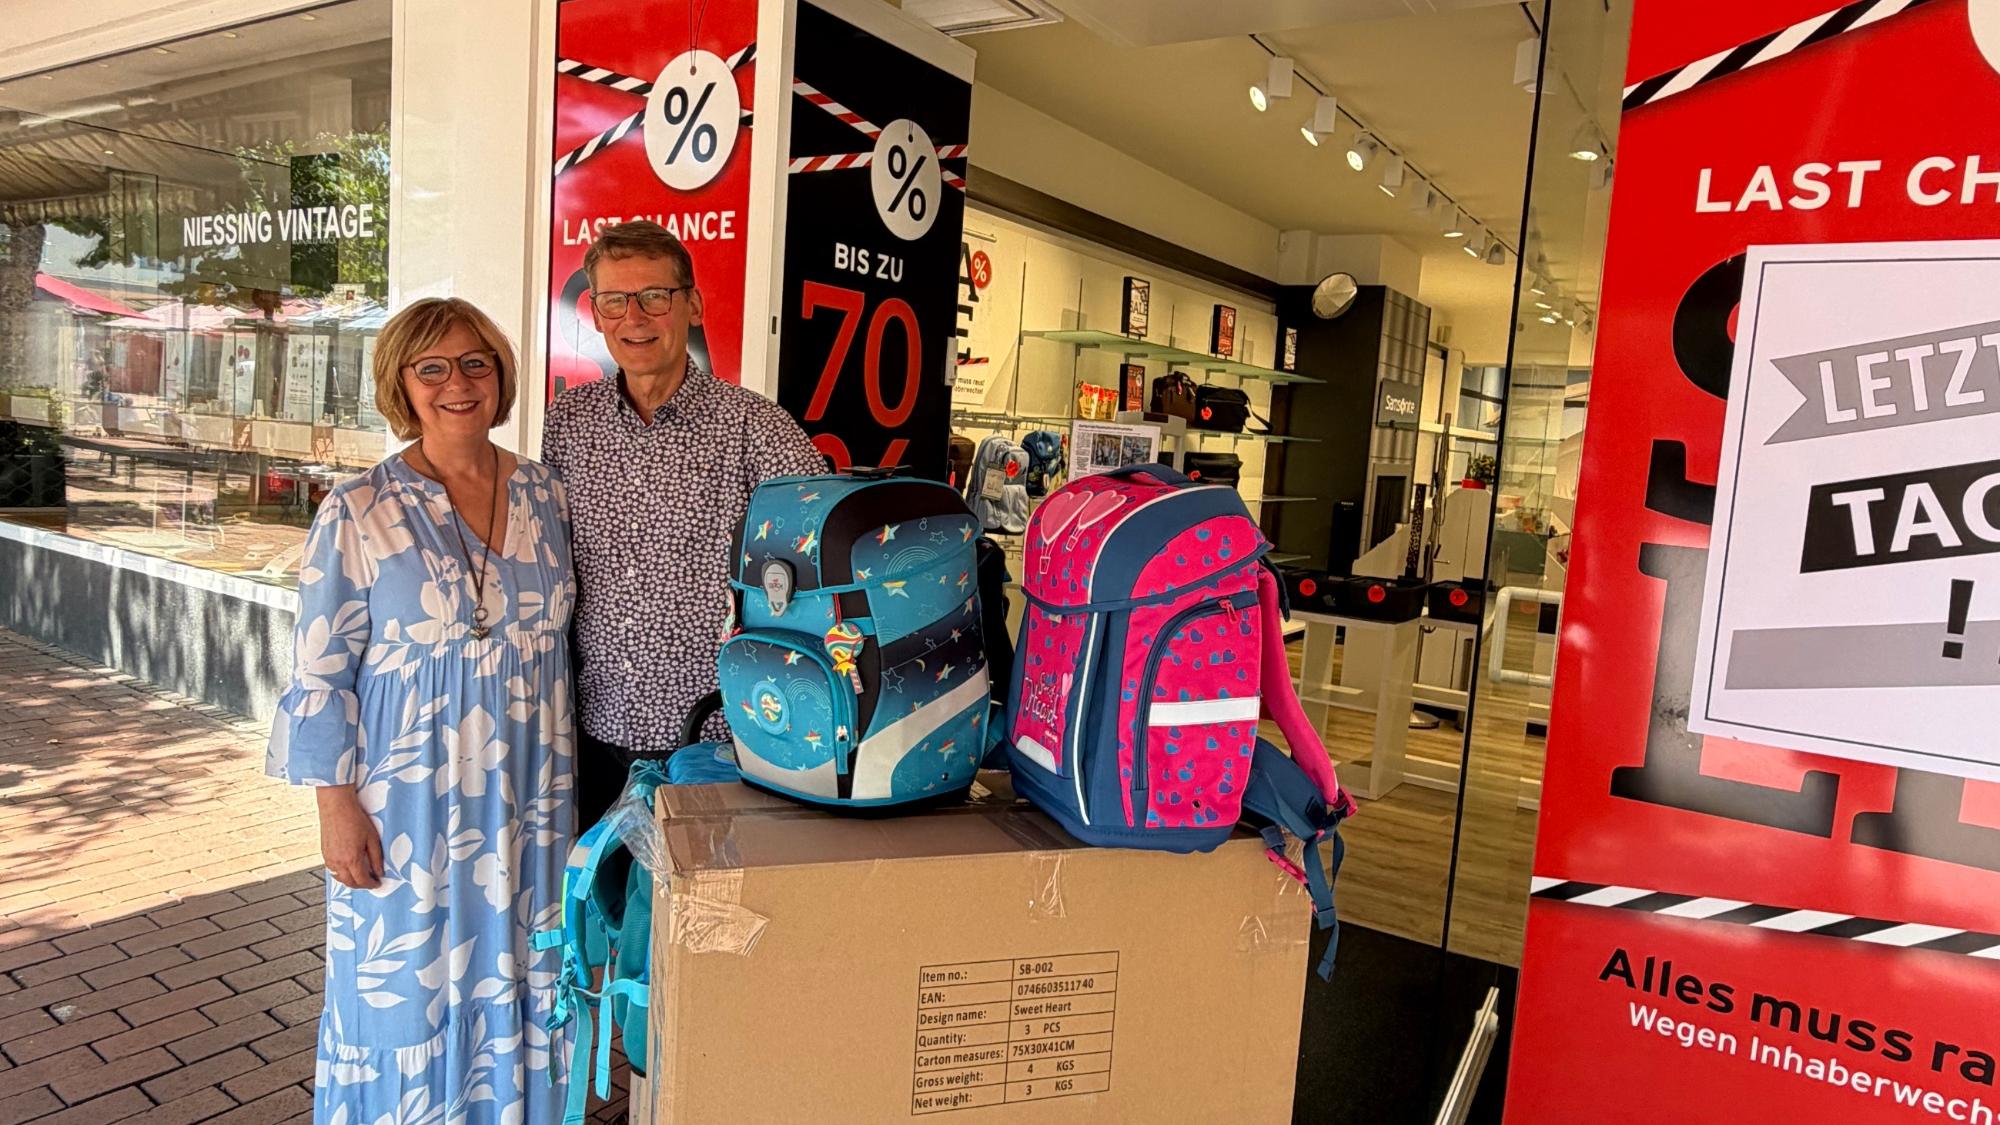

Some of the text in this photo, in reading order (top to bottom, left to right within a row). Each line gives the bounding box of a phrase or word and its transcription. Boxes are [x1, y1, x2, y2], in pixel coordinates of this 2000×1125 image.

[663, 82, 718, 165] %
[887, 144, 927, 222] %
[1695, 160, 1882, 213] LAST
[183, 203, 374, 247] NIESSING VINTAGE
[563, 210, 736, 246] LAS ANCE
[834, 242, 903, 283] BIS ZU
[802, 280, 922, 428] 70
[1942, 578, 1975, 660] !
[921, 978, 1094, 1004] EAN: 0746603511740
[922, 962, 1054, 983] Item no.: SB-002
[919, 1002, 1072, 1025] Design name: Sweet Heart
[1598, 948, 1996, 1087] Alles muss ra
[917, 1040, 1075, 1067] Carton measures: 75X30X41CM
[918, 1021, 1061, 1048] Quantity: 3 PCS
[916, 1060, 1075, 1089] Gross weight: 4 KGS
[1629, 1002, 2000, 1125] Wegen Inhaberwech
[914, 1079, 1073, 1109] Net weight: 3 KGS
